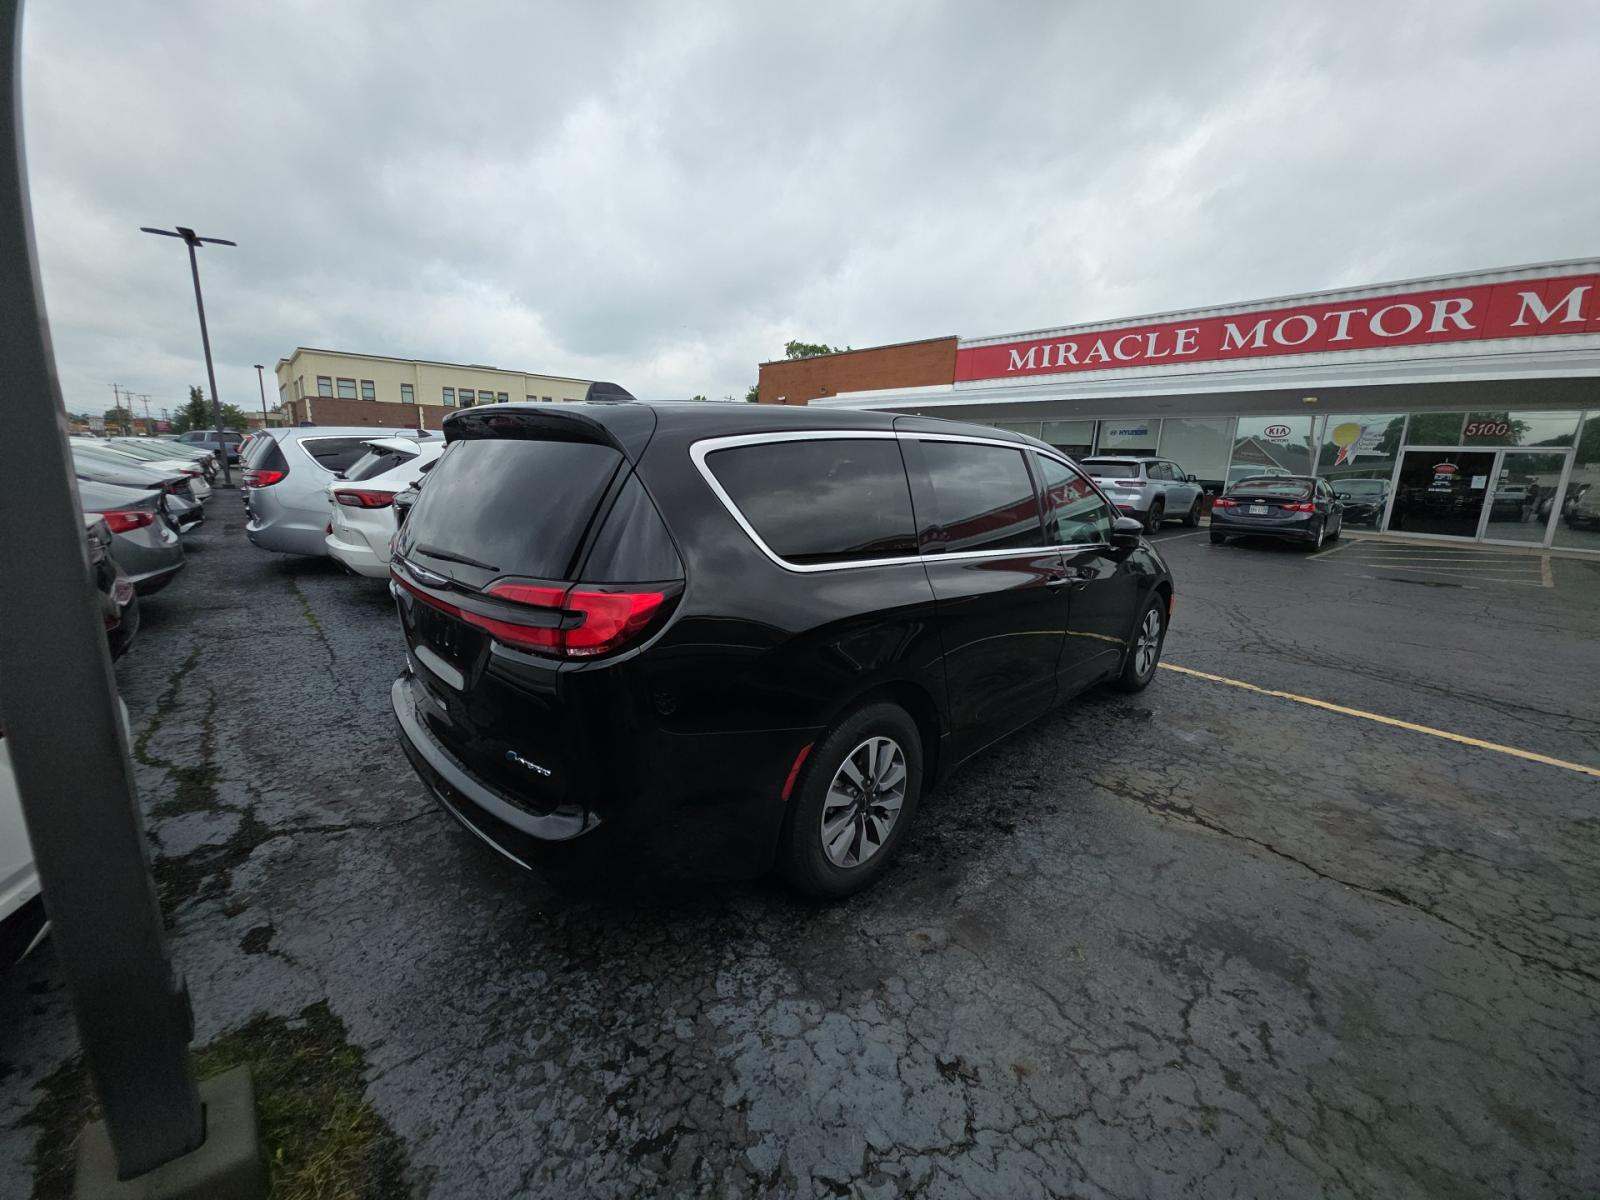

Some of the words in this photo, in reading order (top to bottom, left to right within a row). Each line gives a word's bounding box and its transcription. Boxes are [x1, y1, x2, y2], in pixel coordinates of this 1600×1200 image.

[1007, 327, 1200, 372] MIRACLE
[1220, 297, 1477, 351] MOTOR
[1511, 285, 1600, 328] M
[1465, 422, 1508, 437] 5100
